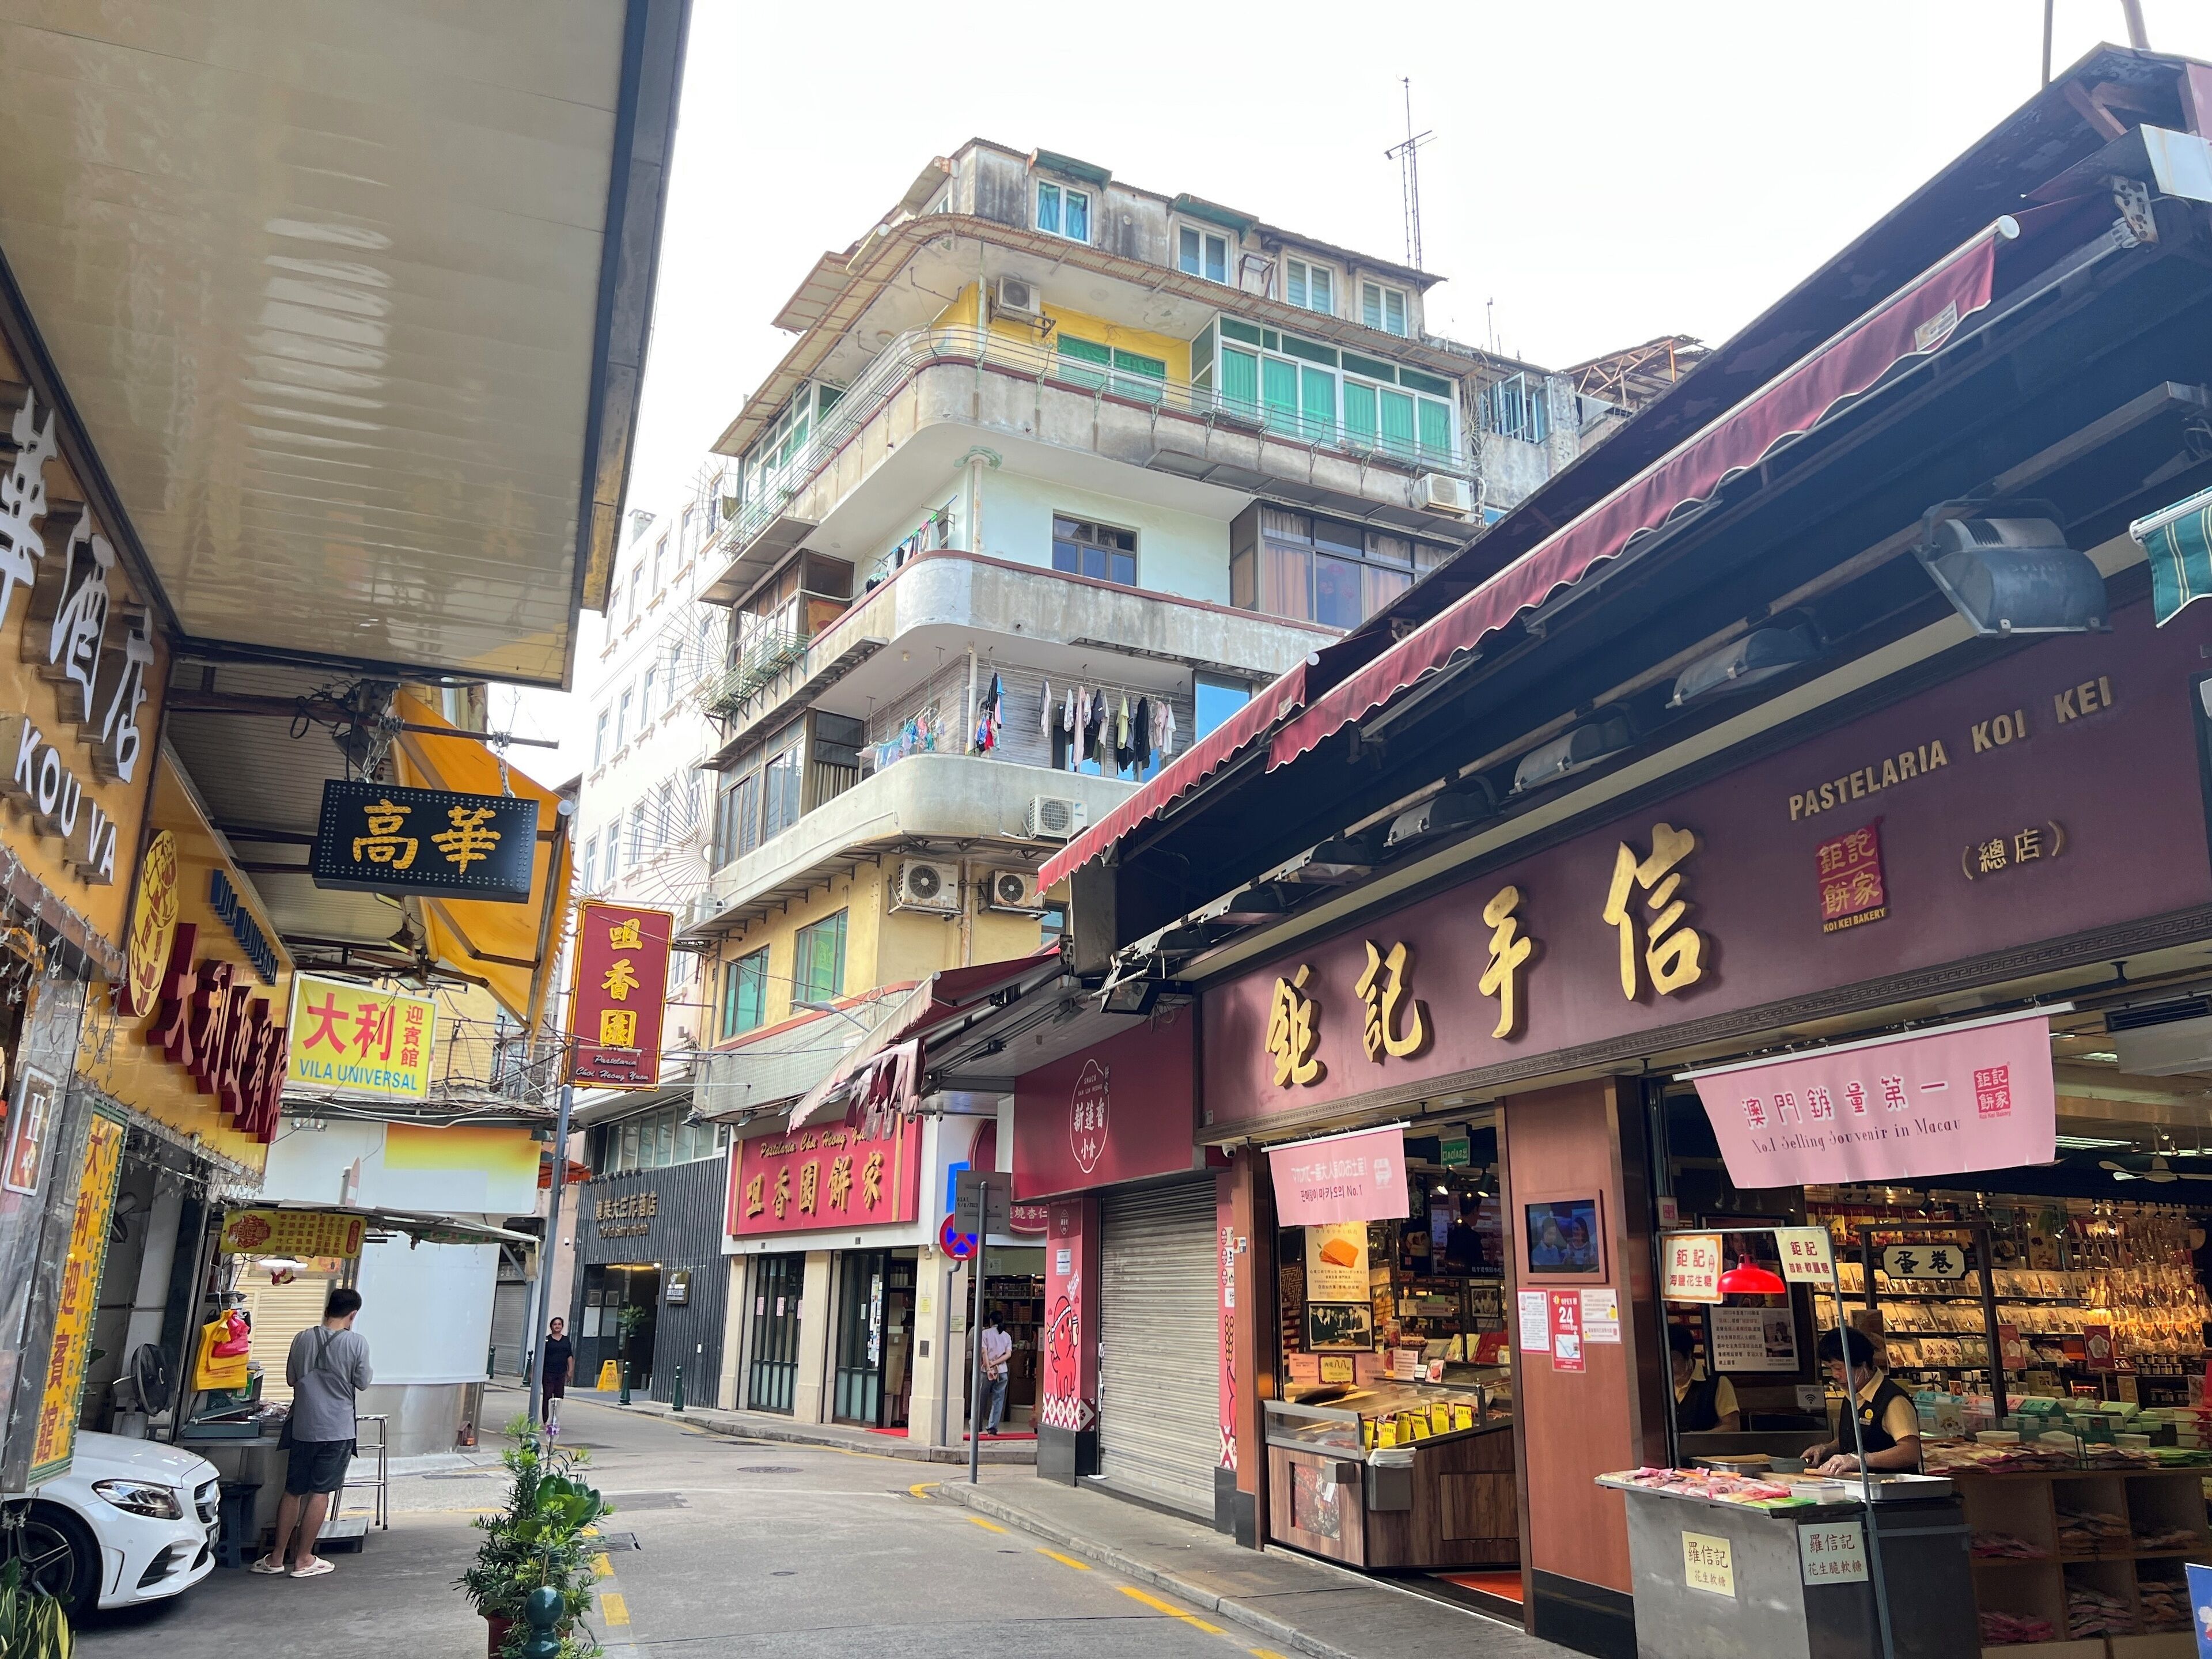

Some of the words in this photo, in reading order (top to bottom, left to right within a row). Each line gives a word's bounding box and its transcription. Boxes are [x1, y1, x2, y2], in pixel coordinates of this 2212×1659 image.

[1789, 740, 1949, 821] PASTELARIA
[1971, 709, 2027, 753] KOI
[2054, 676, 2112, 724] KEI
[14, 718, 82, 838] KOU
[88, 802, 117, 884] VA
[353, 798, 502, 875] 高華
[1819, 830, 1876, 875] 鉅記
[1822, 872, 1881, 915] 餅家
[1823, 922, 1838, 933] KOI
[1839, 917, 1853, 929] KEI
[1853, 907, 1886, 925] BAKERY
[1265, 822, 1710, 1089] 鉅記手信
[600, 918, 643, 1048] 咀香園
[302, 993, 396, 1061] 大利
[400, 1005, 423, 1068] 迎賓館
[575, 1066, 595, 1078] Choi
[600, 1070, 626, 1081] Heong
[629, 1071, 650, 1081] Yuen
[593, 1054, 637, 1066] Pastelaria
[299, 1059, 332, 1081] VILA
[338, 1066, 418, 1091] UNIVERSAL
[1975, 1067, 2009, 1089] 鉅記
[1741, 1075, 1946, 1128] 澳門銷量第一
[1977, 1090, 2010, 1111] 餅家
[1073, 1097, 1105, 1134] 新蓮香
[1081, 1137, 1096, 1161] 小食
[1752, 1136, 1777, 1154] No.1
[1781, 1132, 1826, 1153] Selling
[1828, 1127, 1888, 1145] Souvenir
[1894, 1123, 1910, 1137] in
[1915, 1116, 1961, 1135] Macau
[746, 1152, 885, 1219] 咀香園餅家
[1319, 1184, 1344, 1200] 마카오의
[1676, 1248, 1706, 1268] 鉅記
[1790, 1241, 1817, 1256] 鉅記
[1893, 1250, 1953, 1275] 蛋卷
[1558, 1305, 1574, 1330] 24
[1687, 1540, 1729, 1569] 羅信記
[1809, 1533, 1855, 1553] 羅信記
[1694, 1569, 1726, 1588] 花生軟糖
[1807, 1559, 1863, 1576] 花生脆軟糖
